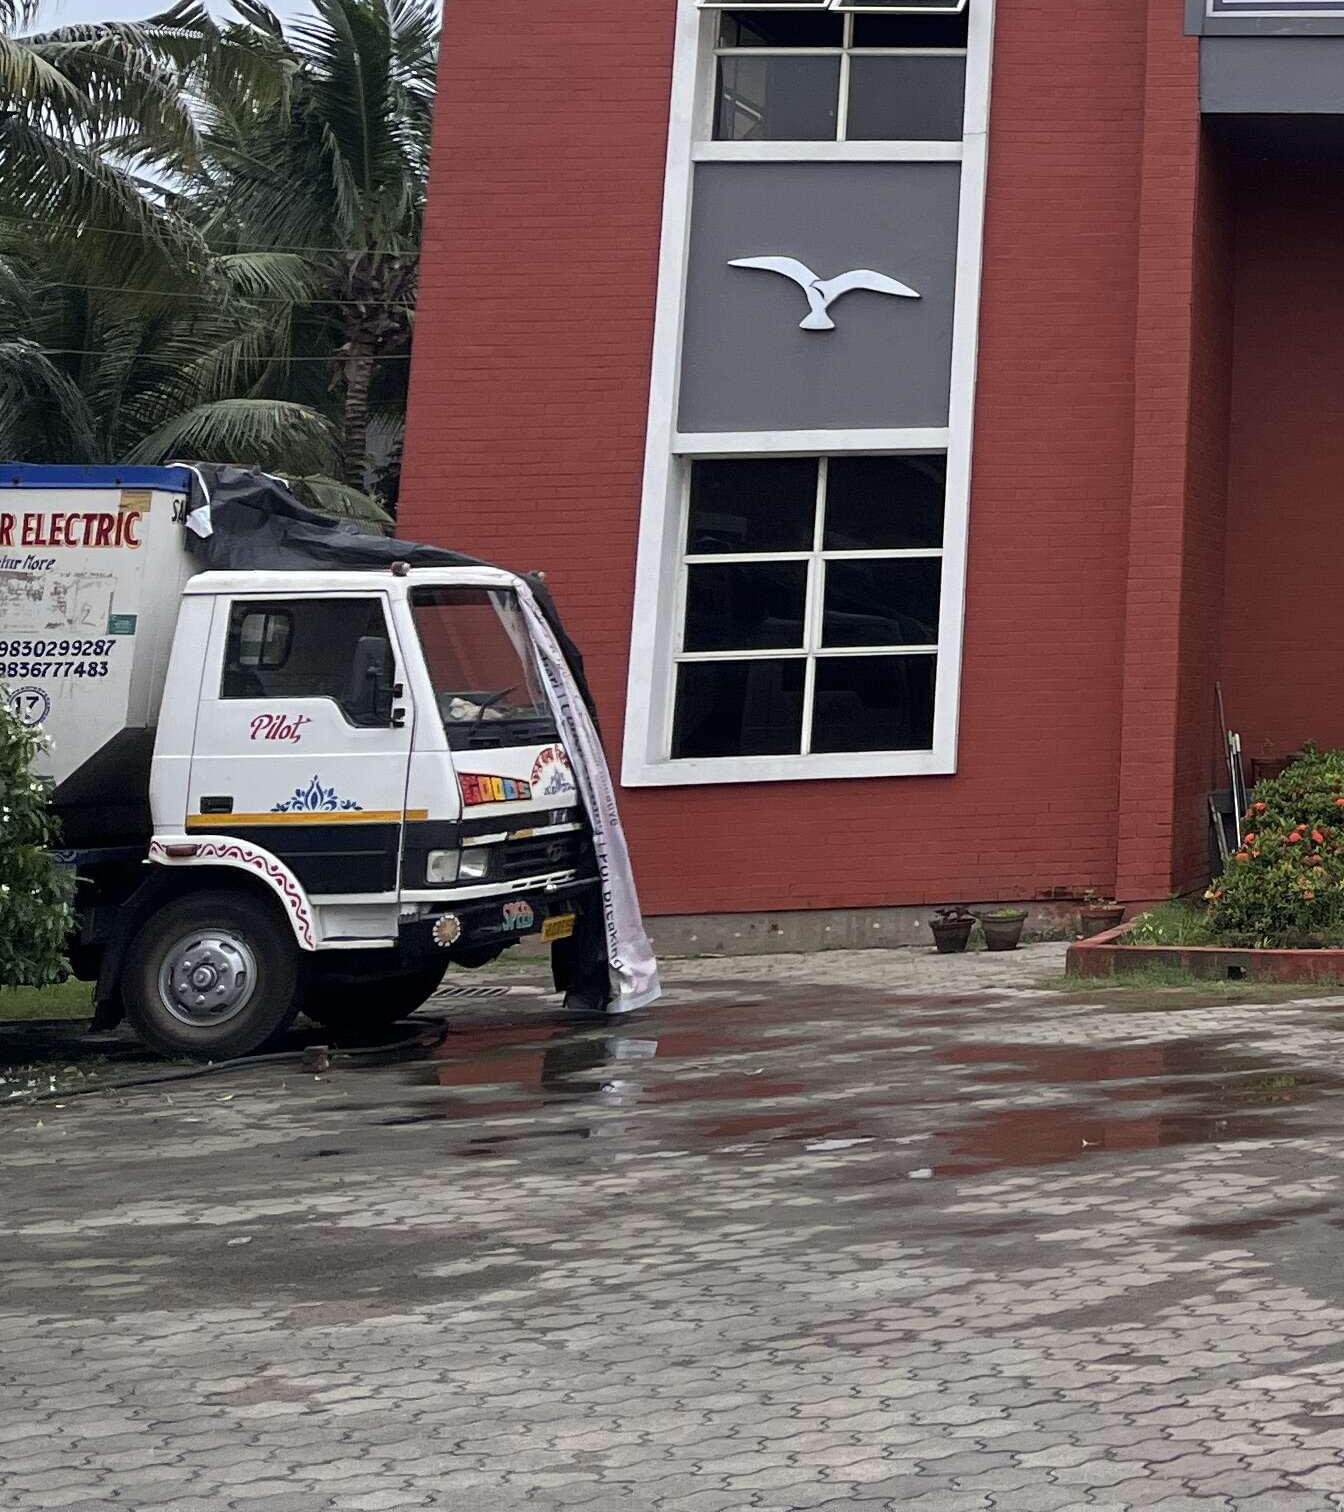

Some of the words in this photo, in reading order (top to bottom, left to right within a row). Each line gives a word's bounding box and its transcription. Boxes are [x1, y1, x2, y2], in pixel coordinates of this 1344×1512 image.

[21, 512, 142, 547] ELECTRIC
[0, 640, 117, 657] 9830299287
[250, 714, 312, 744] Pilot
